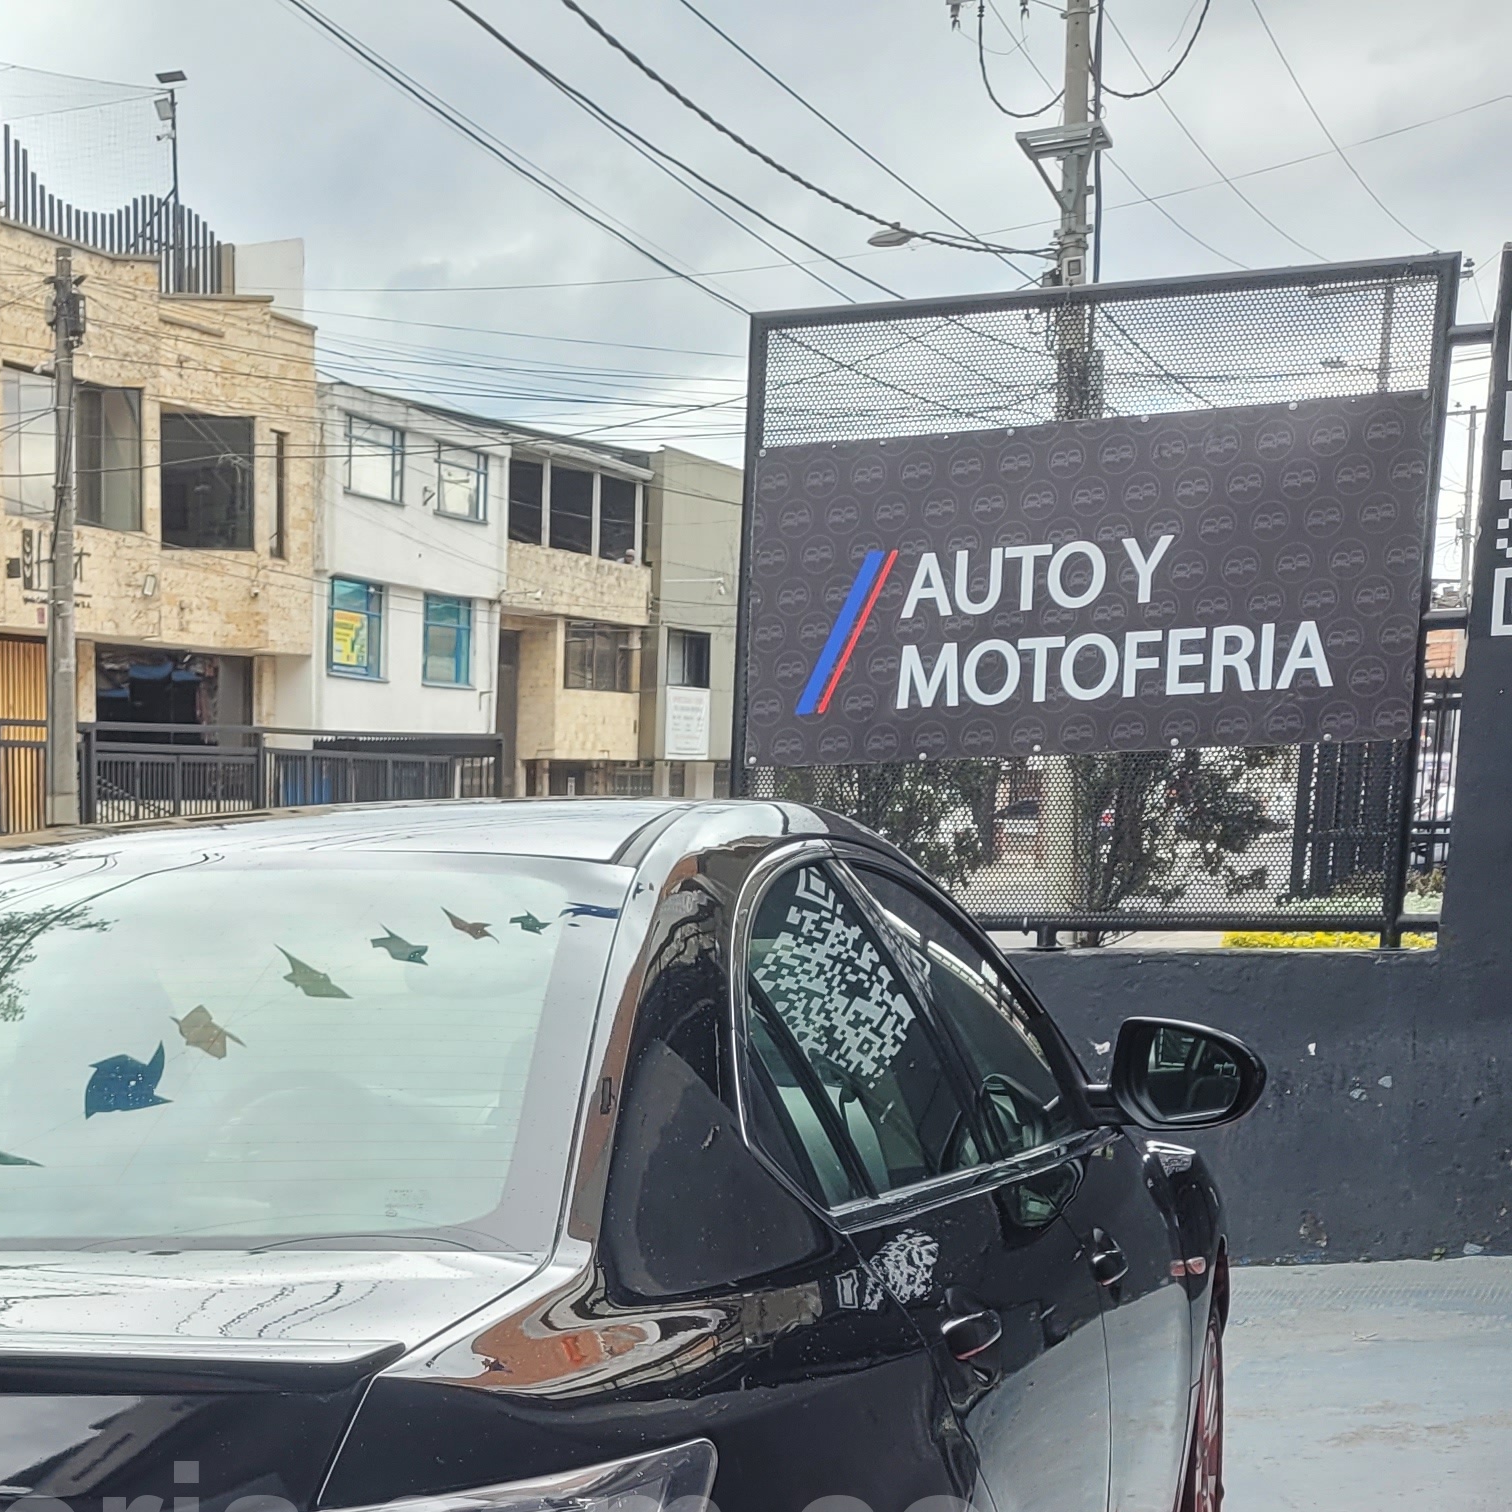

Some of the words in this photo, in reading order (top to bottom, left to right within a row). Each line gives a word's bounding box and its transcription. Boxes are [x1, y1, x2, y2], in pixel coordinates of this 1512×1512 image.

[899, 540, 1108, 619] AUTO
[1120, 534, 1176, 604] Y
[895, 619, 1335, 710] MOTOFERIA
